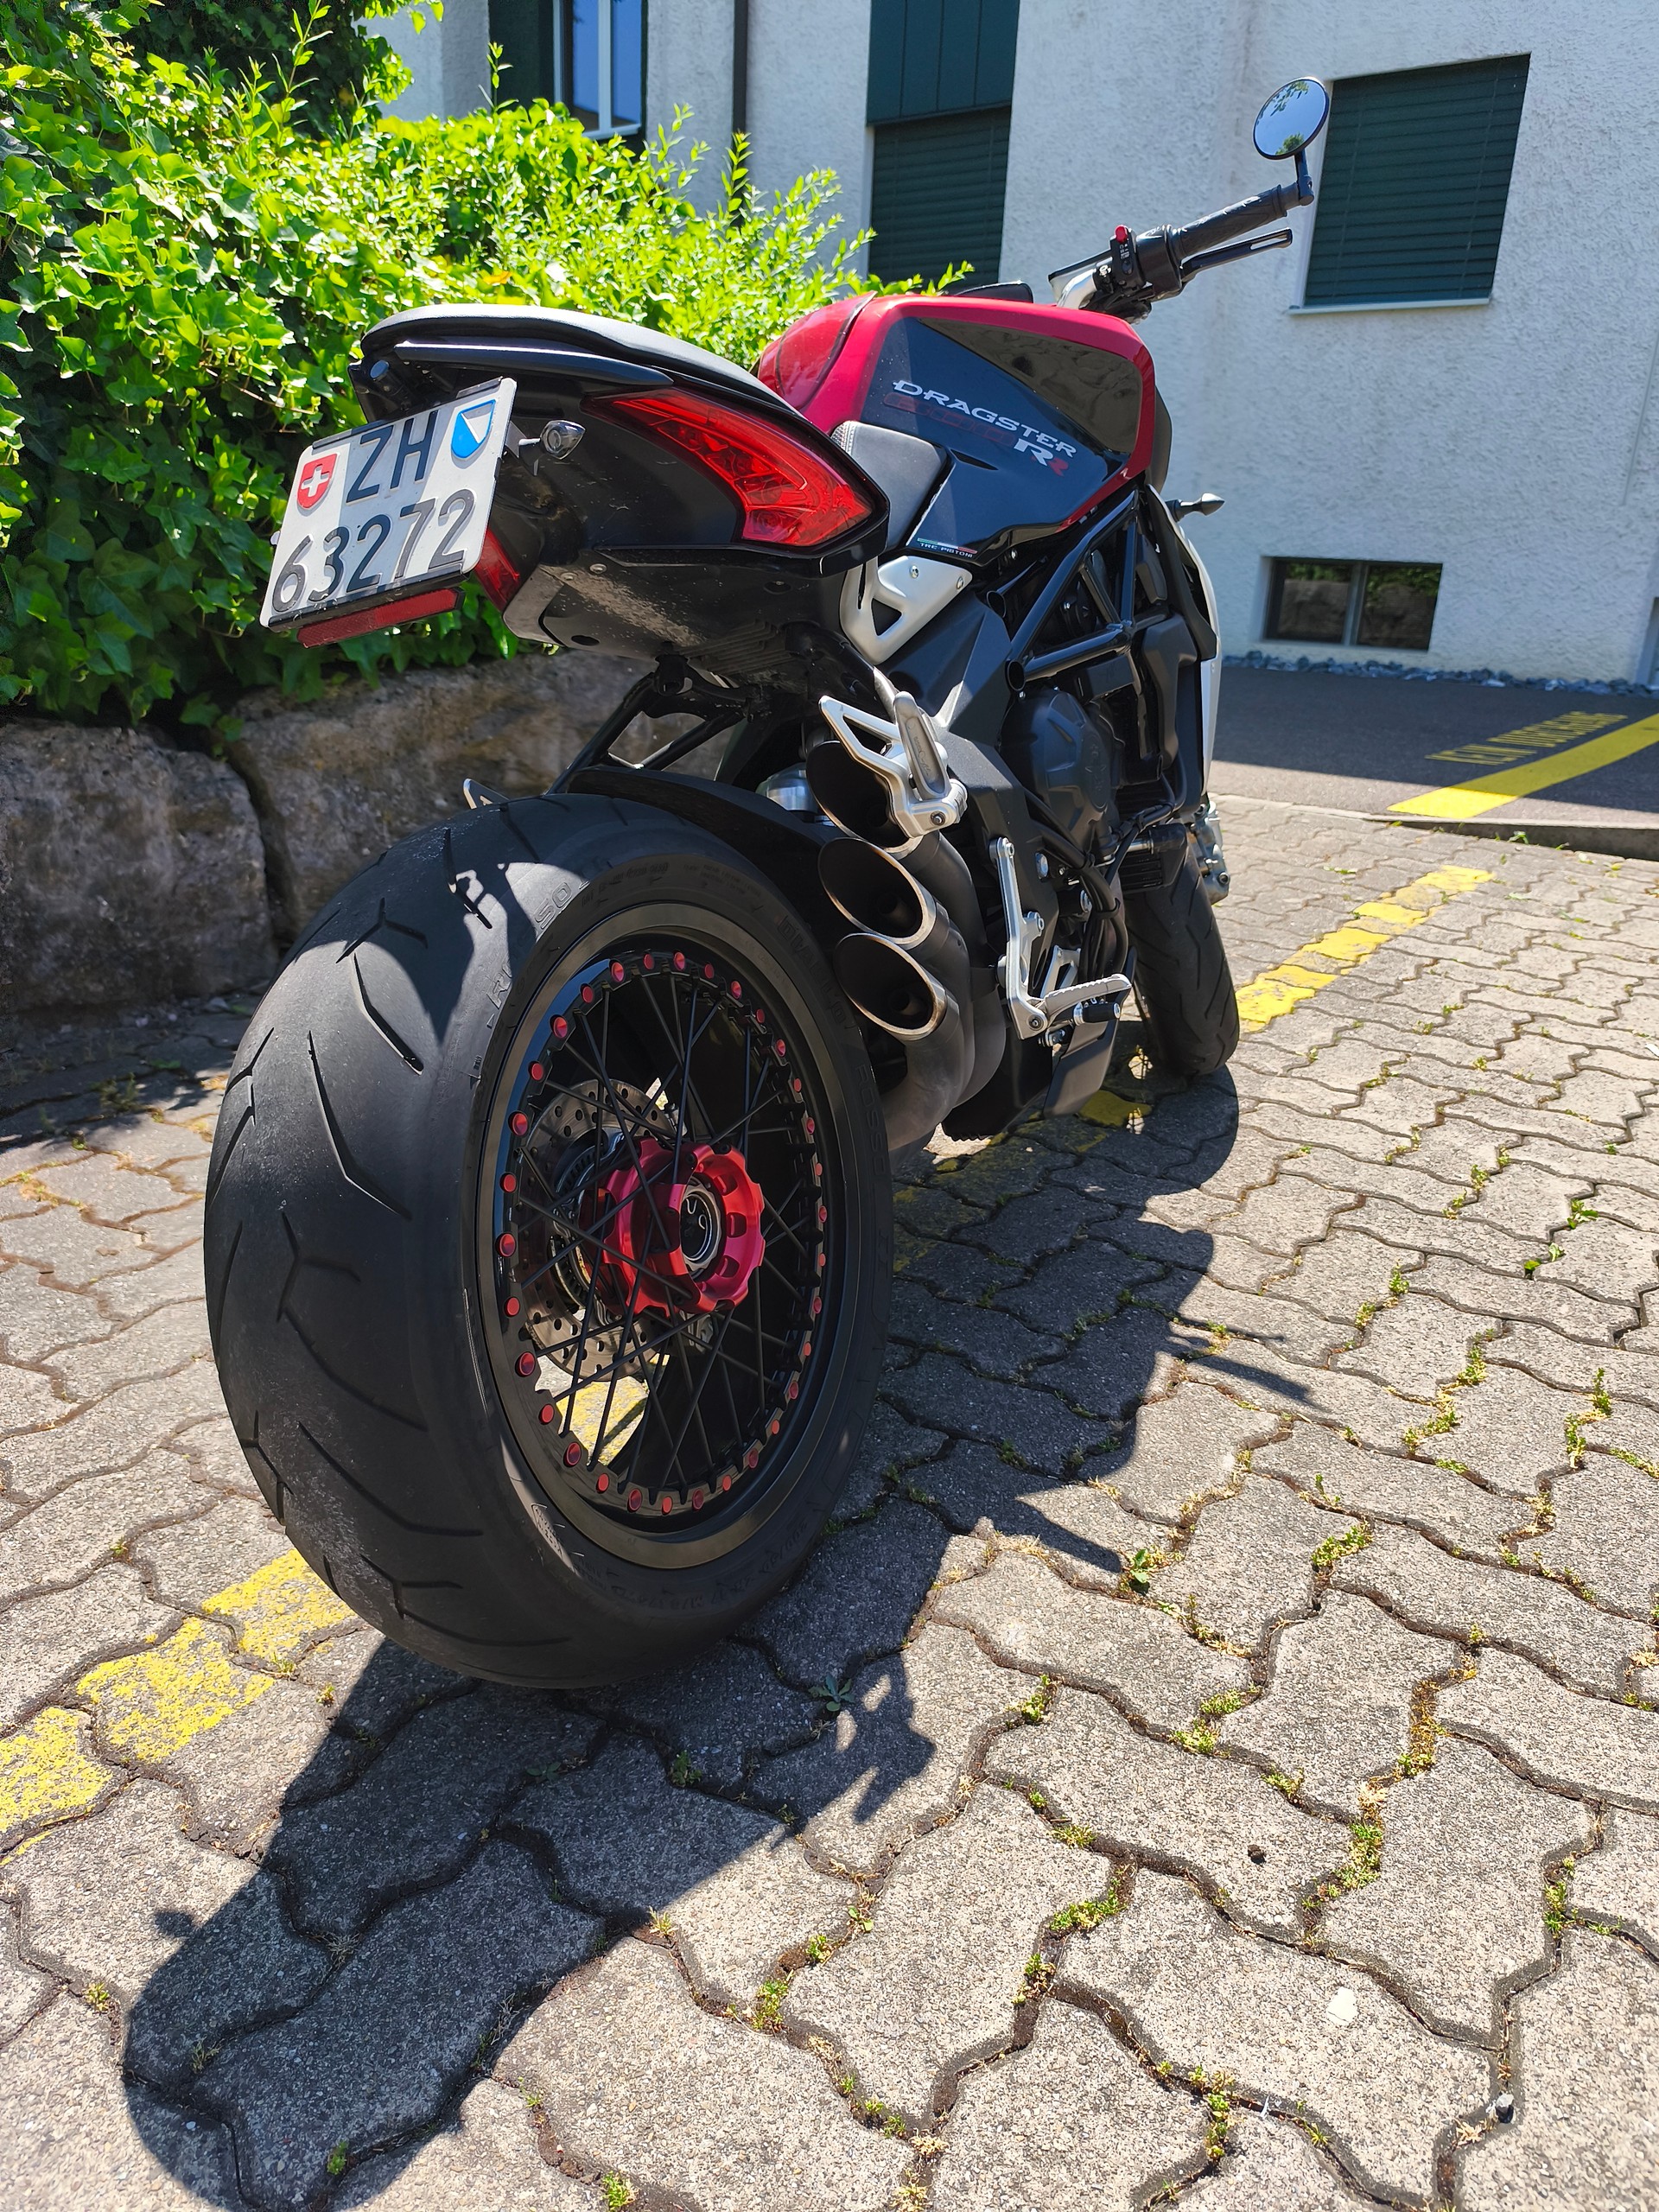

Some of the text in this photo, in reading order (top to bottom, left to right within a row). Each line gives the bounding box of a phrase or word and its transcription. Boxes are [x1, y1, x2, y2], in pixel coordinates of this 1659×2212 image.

[346, 410, 438, 504] ZH
[893, 379, 1077, 458] DRAGSTER
[271, 488, 477, 613] 63272
[940, 547, 973, 558] PISTONI
[855, 1064, 887, 1177] ROSSO
